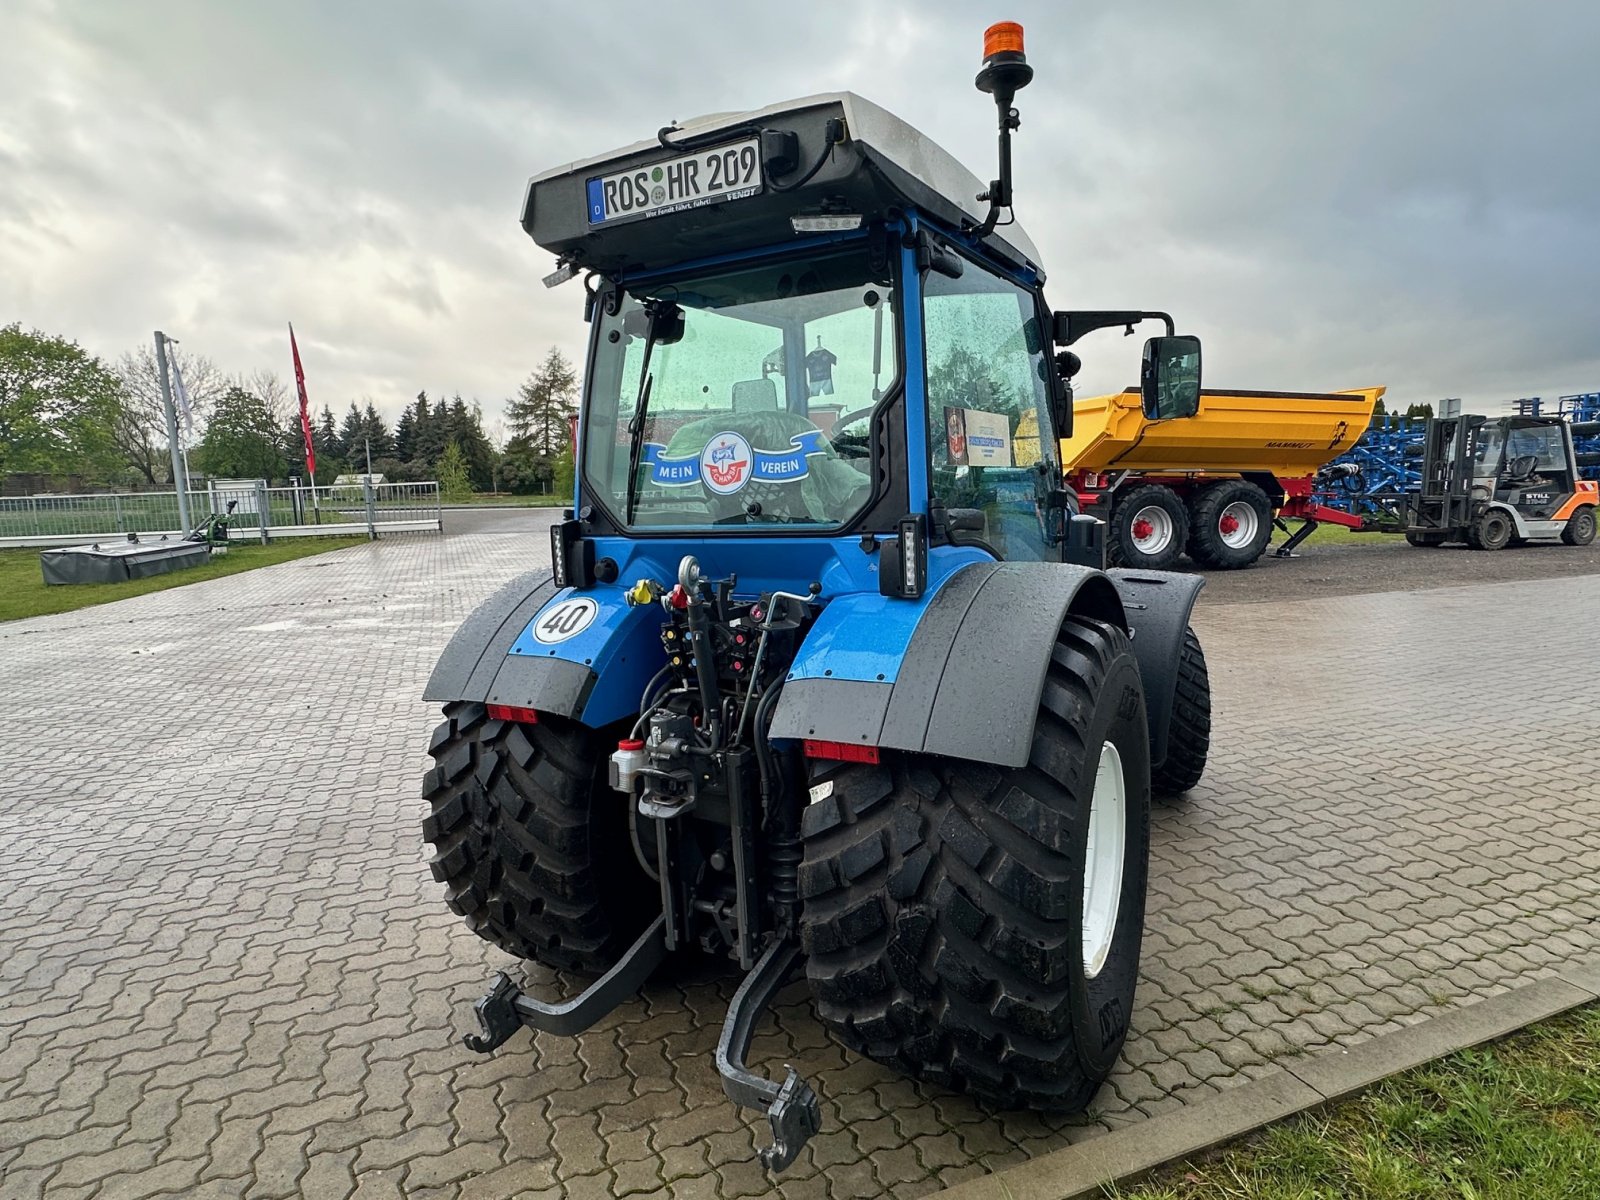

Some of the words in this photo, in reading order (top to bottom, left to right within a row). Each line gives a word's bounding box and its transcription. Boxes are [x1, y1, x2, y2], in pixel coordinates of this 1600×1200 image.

[603, 172, 650, 215] ROS
[667, 159, 701, 200] HR
[706, 146, 756, 191] 209
[726, 187, 757, 201] FENDT
[594, 205, 600, 215] D
[658, 205, 674, 215] Fendt
[1264, 441, 1316, 449] MAMMUT
[1465, 431, 1473, 457] STILL
[659, 465, 693, 478] MEIN
[761, 459, 800, 474] VEREIN
[541, 605, 589, 634] 40
